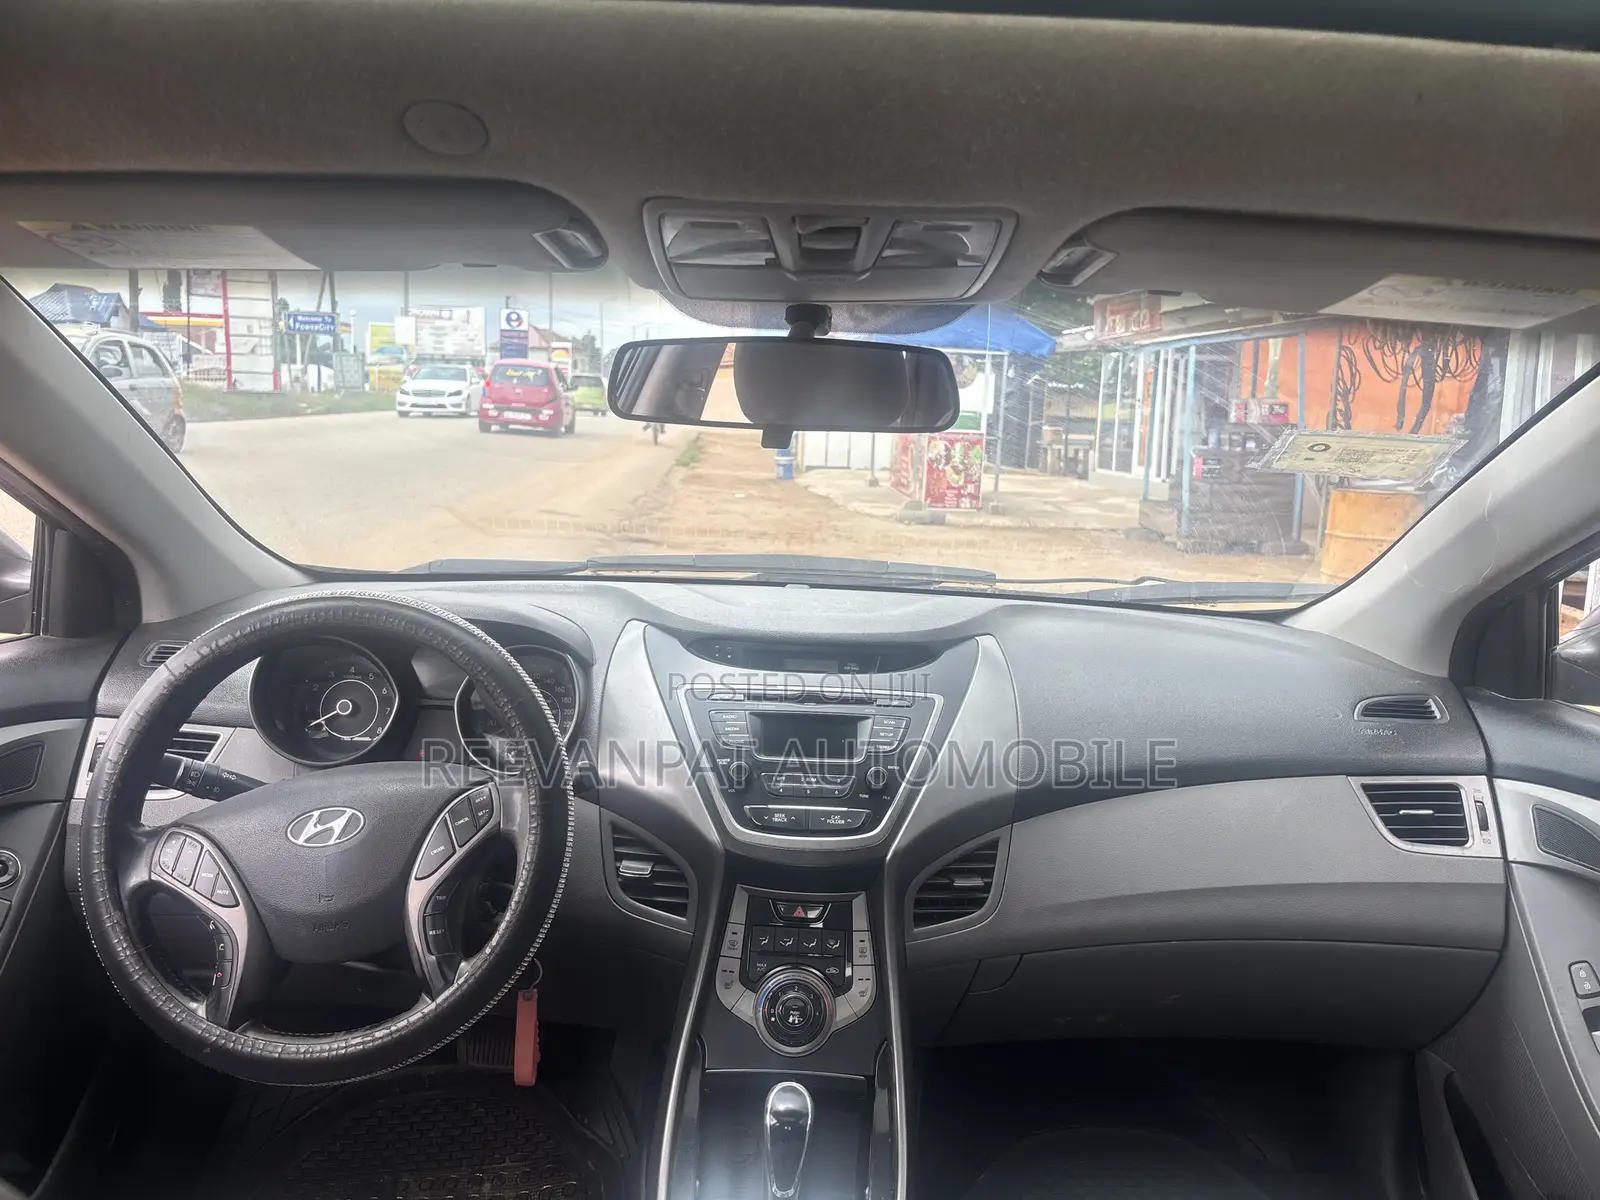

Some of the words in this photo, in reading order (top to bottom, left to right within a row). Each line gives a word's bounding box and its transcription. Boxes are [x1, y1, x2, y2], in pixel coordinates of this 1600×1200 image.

[349, 666, 356, 674] 4
[368, 672, 375, 680] 5
[381, 687, 388, 695] 6
[385, 707, 391, 716] 7
[563, 708, 575, 716] 200
[376, 726, 383, 735] 8
